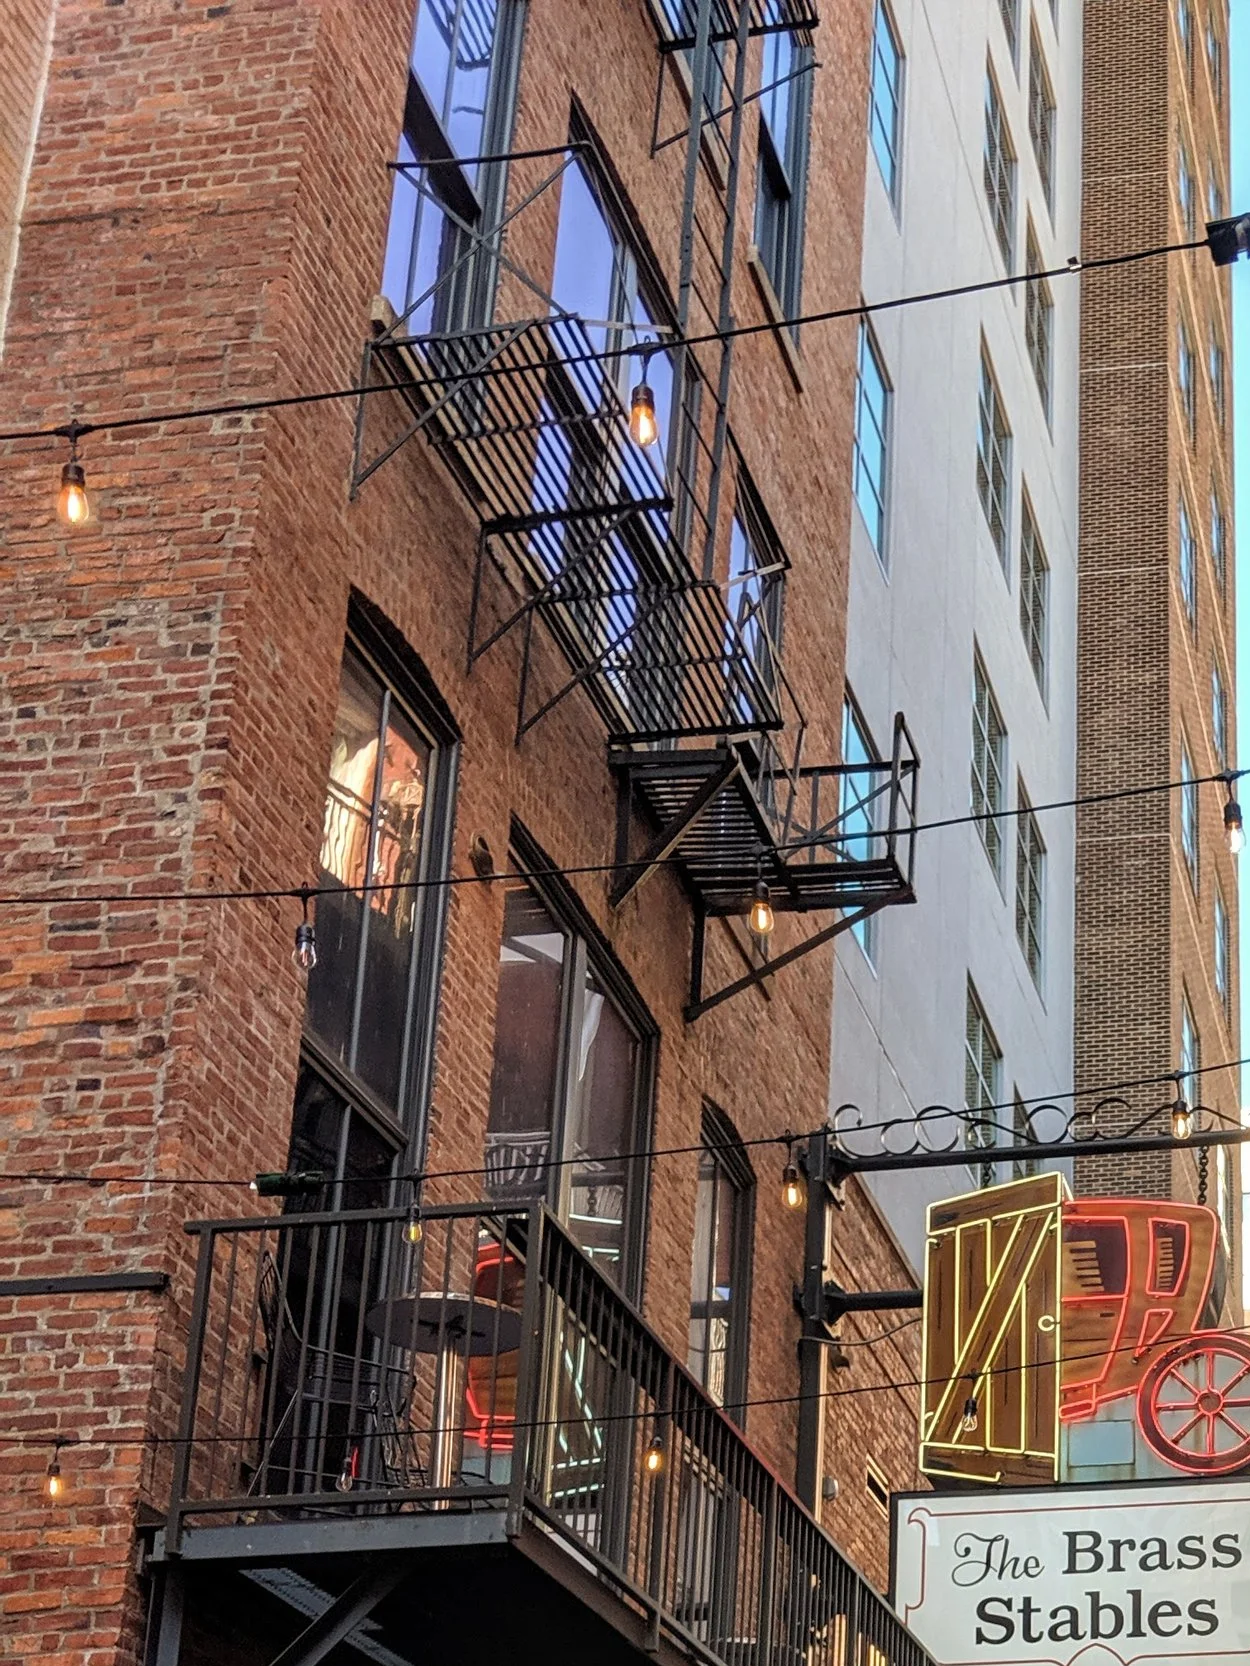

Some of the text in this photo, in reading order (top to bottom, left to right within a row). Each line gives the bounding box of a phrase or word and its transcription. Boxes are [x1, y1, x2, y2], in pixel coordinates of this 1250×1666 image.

[952, 1529, 1243, 1587] The Brass
[975, 1589, 1220, 1645] Stables
